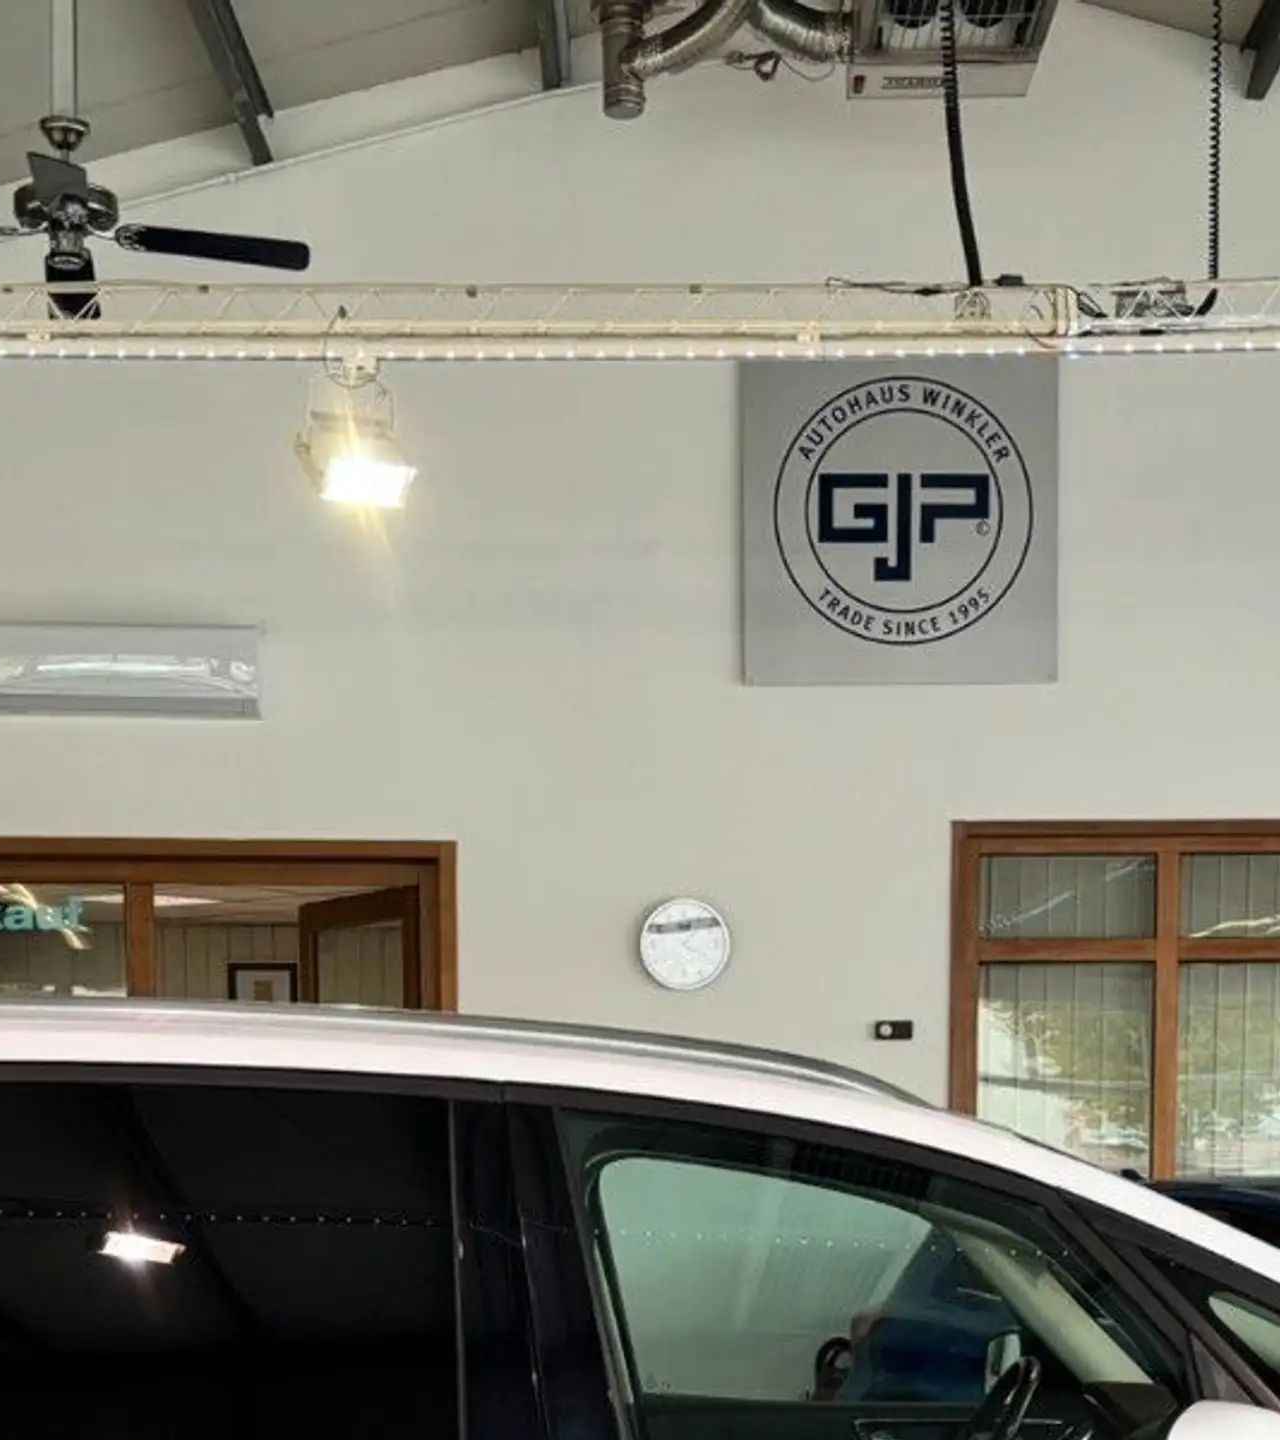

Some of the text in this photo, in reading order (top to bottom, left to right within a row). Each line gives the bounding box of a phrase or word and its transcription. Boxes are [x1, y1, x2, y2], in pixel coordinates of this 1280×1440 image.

[797, 384, 1011, 464] AUTOHAUS WINKLER
[818, 473, 990, 582] GJP
[818, 586, 991, 636] TRADE SINCE 1995
